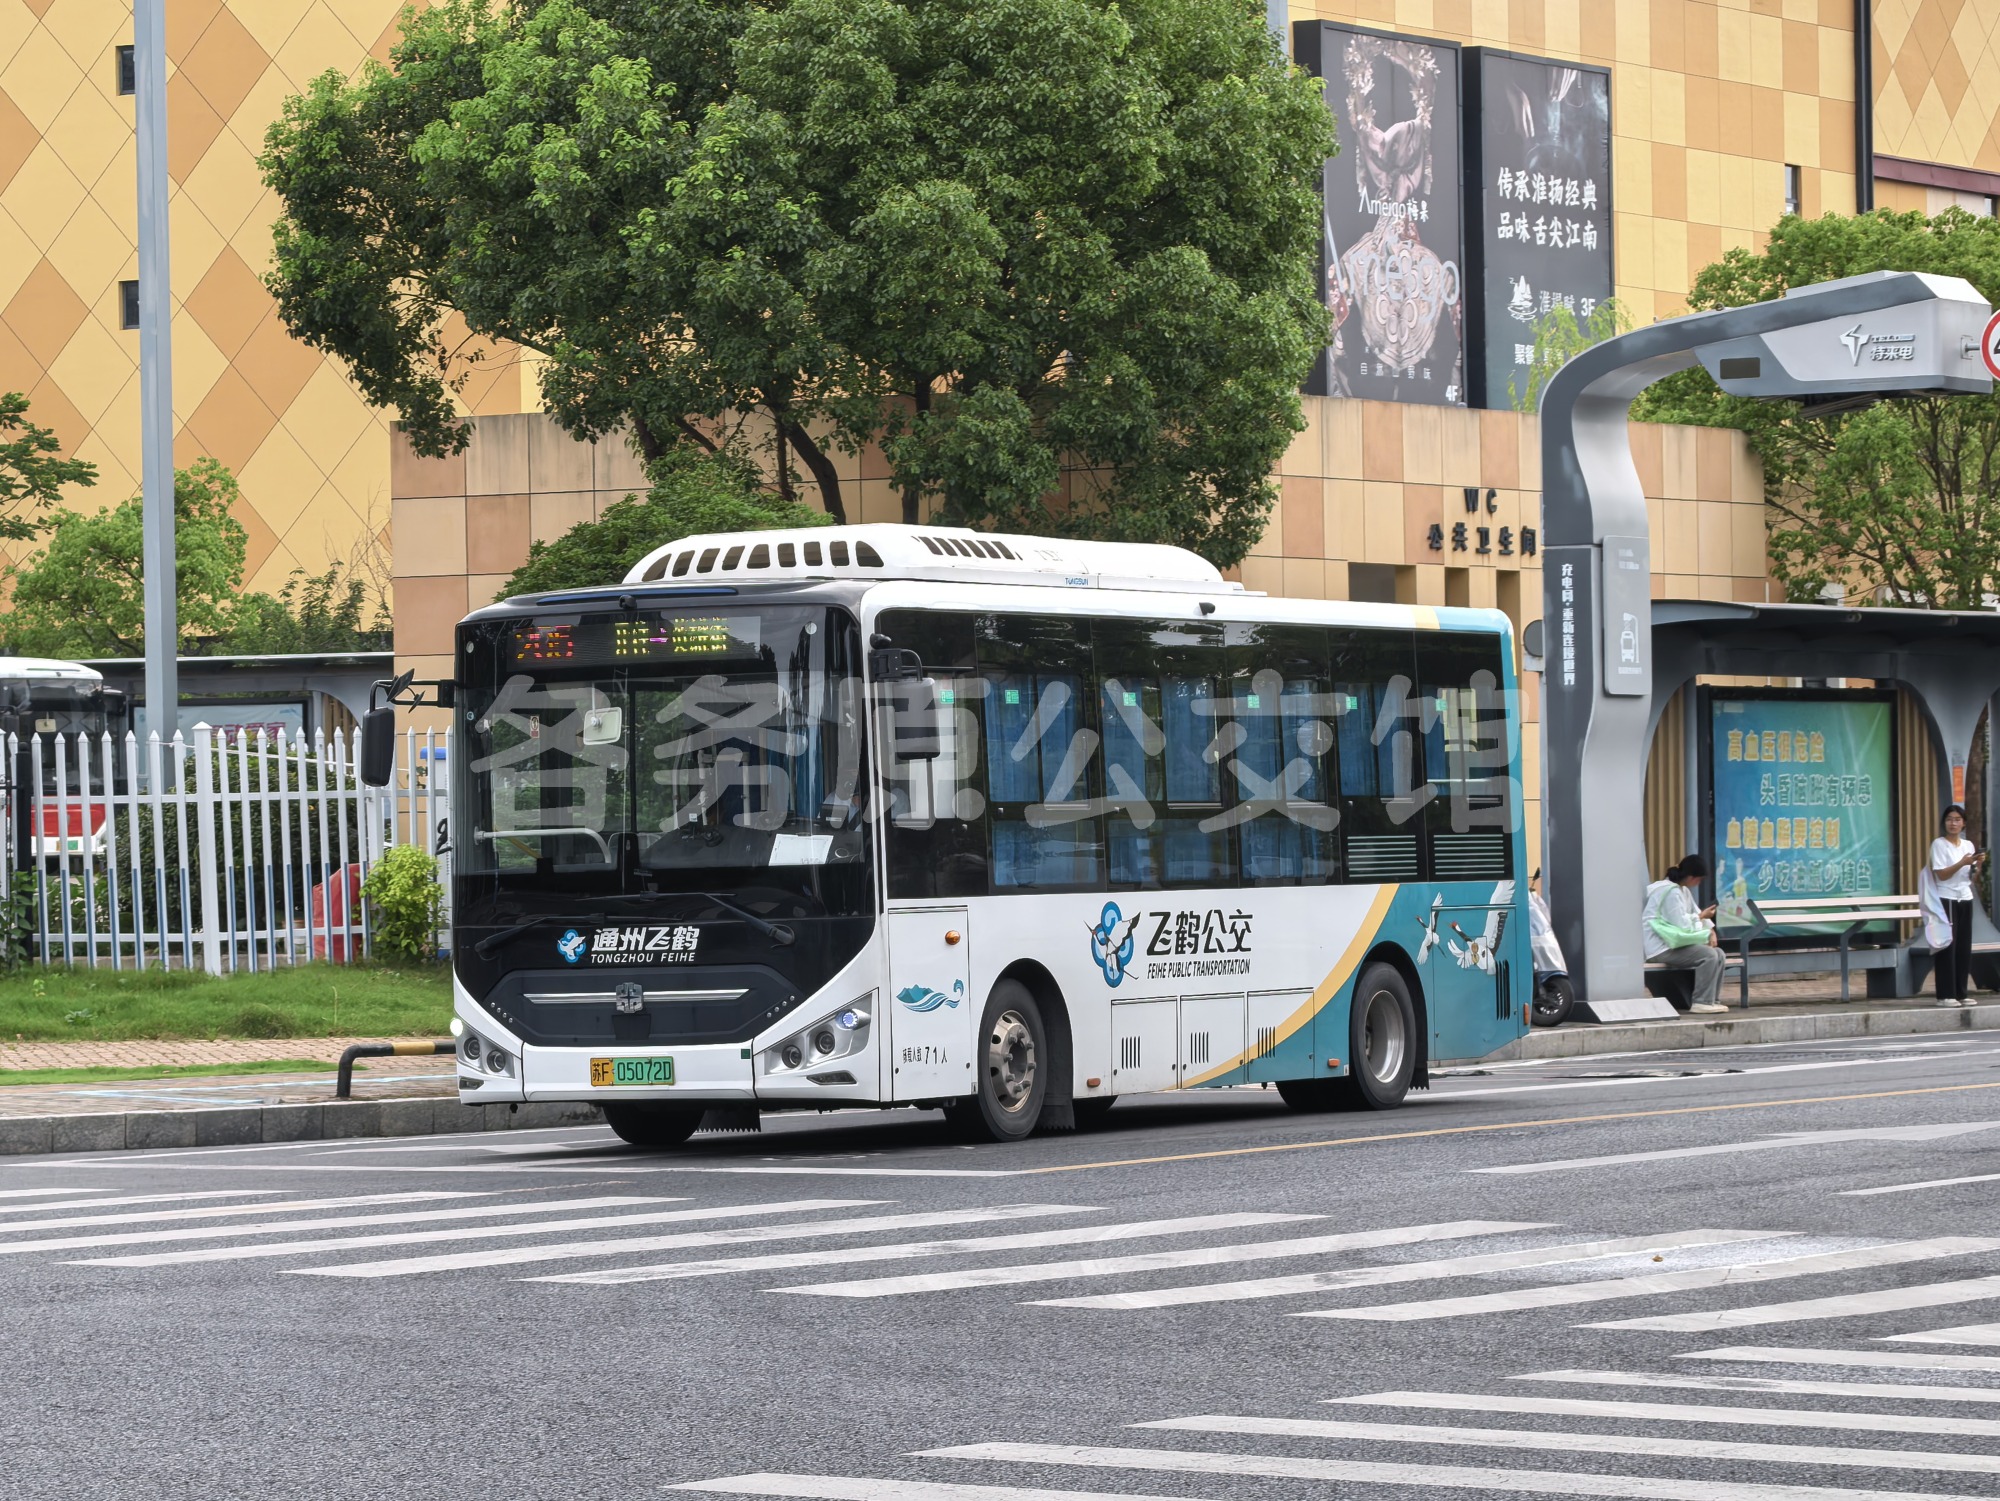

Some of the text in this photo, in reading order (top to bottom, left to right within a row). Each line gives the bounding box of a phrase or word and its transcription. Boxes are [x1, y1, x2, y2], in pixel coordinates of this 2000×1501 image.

[1497, 166, 1598, 211] 传承淮扬经典
[1497, 211, 1598, 252] 品味舌尖江南
[1580, 297, 1596, 317] 3F
[1870, 345, 1914, 361] 特来电
[1445, 385, 1458, 402] 4F
[1463, 487, 1498, 514] WC
[1427, 521, 1537, 557] 公共卫生间
[591, 926, 700, 951] 通州飞鹤
[1146, 908, 1253, 956] 飞鹤公交
[590, 952, 696, 964] TONGZHOU FEIHE
[1147, 958, 1251, 979] FEIHE PUBLIC TRANSPORTATION
